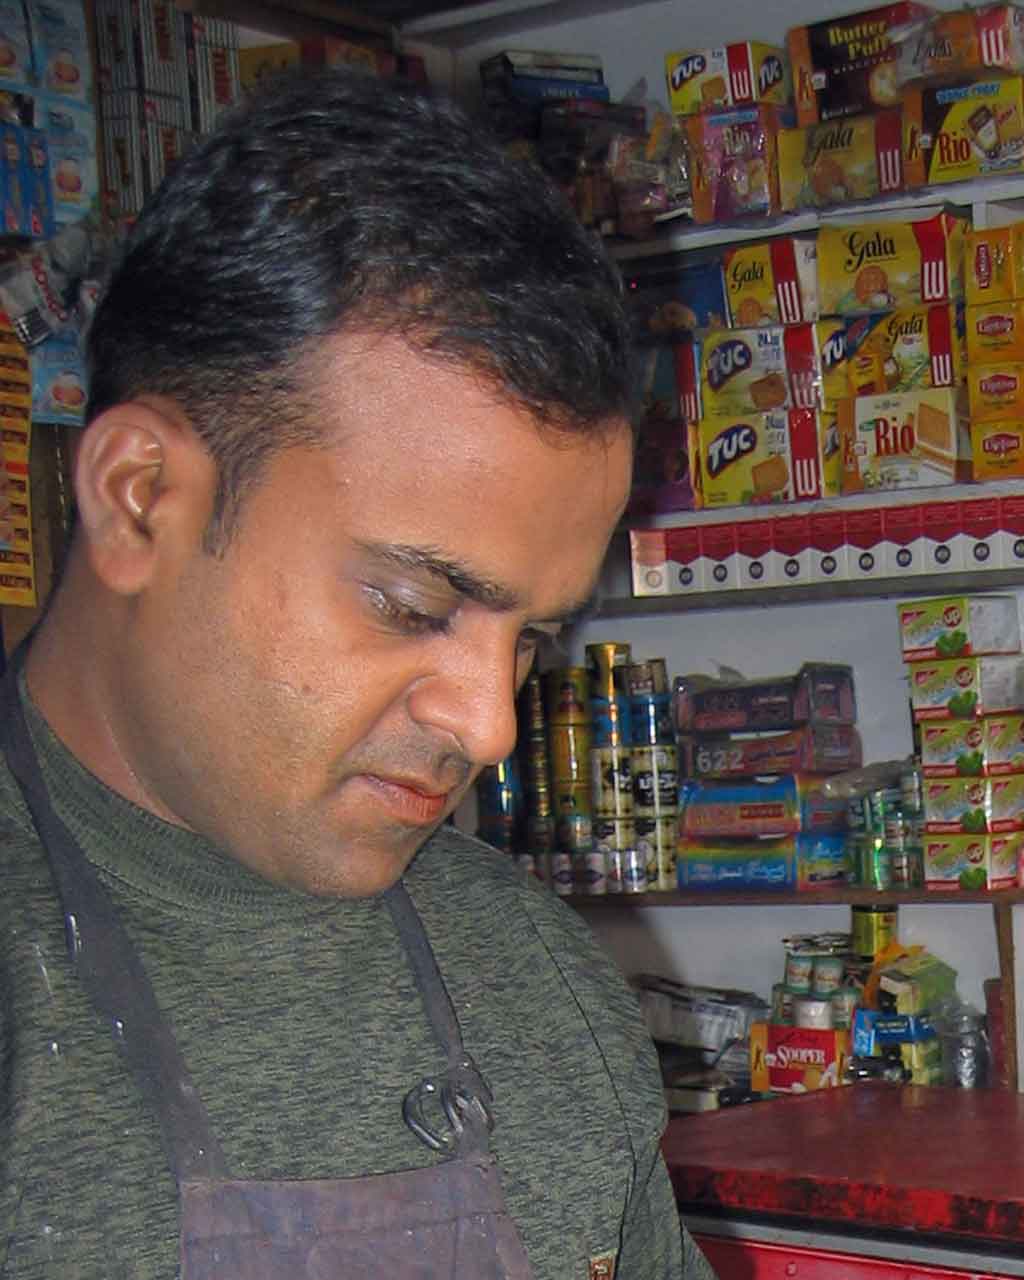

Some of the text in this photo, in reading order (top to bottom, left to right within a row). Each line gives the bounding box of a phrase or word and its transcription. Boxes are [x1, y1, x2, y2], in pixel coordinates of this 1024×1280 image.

[827, 22, 889, 46] Butter
[981, 28, 1004, 65] LU
[672, 55, 705, 87] TUC
[731, 71, 754, 102] LU
[938, 131, 972, 166] Rio
[879, 149, 902, 192] LU
[845, 230, 897, 275] Gala
[730, 260, 765, 293] Gala
[922, 259, 944, 301] LU
[778, 281, 803, 324] LU
[885, 315, 924, 345] Gala
[709, 343, 751, 387] TUC
[822, 333, 847, 367] TU
[932, 353, 953, 385] LU
[709, 428, 755, 475] TUC
[874, 416, 916, 457] Rio
[795, 458, 818, 497] LU
[695, 751, 745, 776] 622
[776, 1045, 826, 1068] SOOPER
